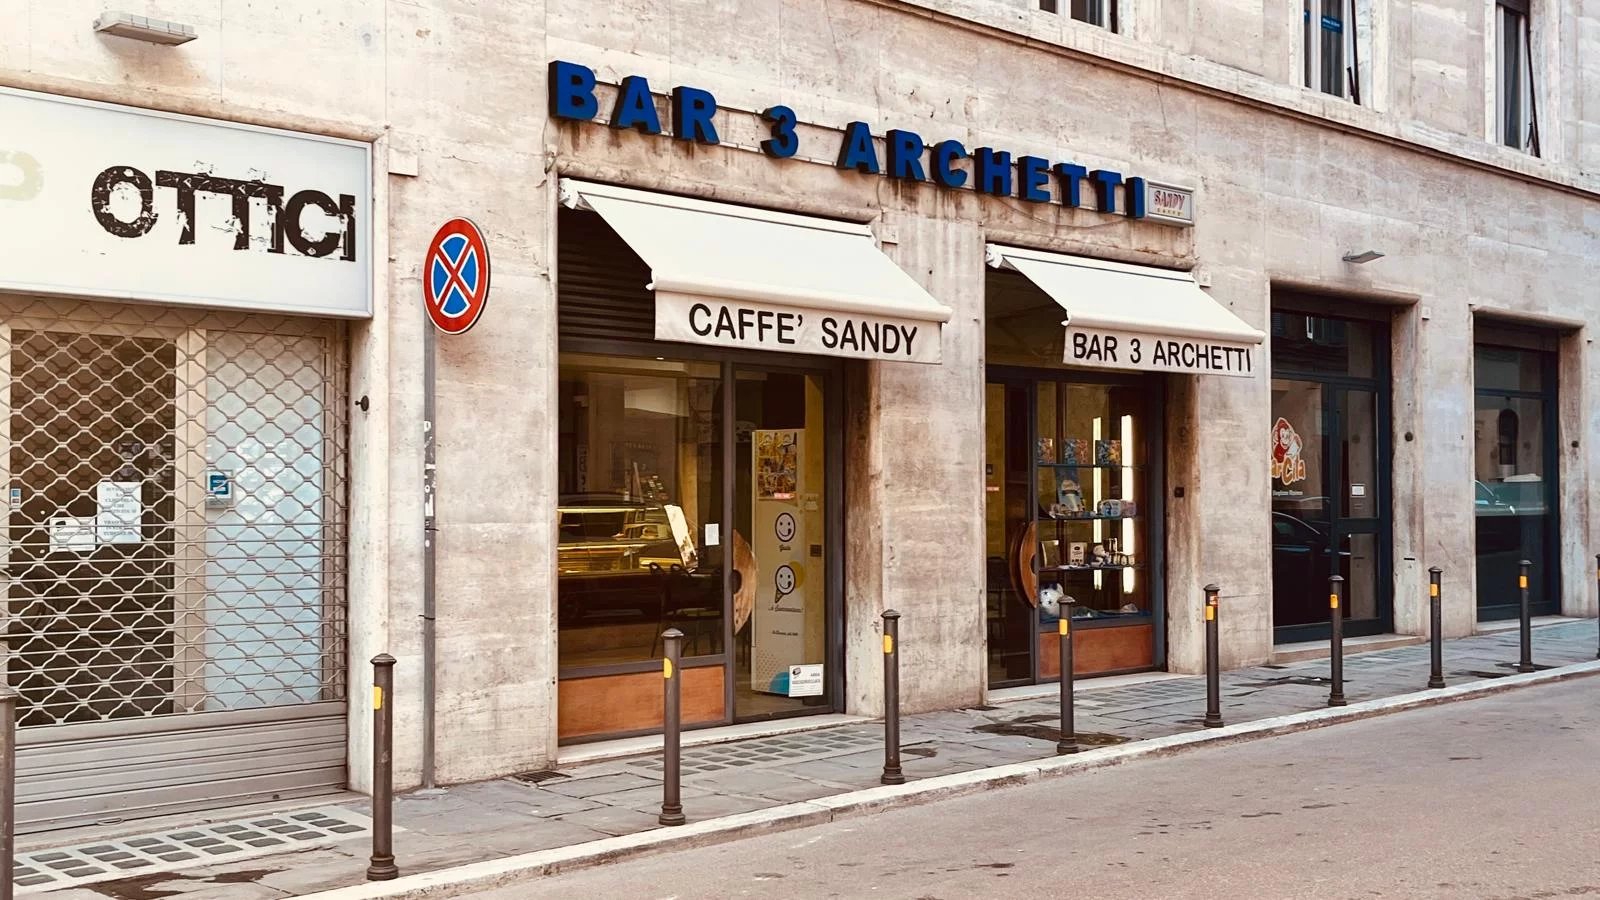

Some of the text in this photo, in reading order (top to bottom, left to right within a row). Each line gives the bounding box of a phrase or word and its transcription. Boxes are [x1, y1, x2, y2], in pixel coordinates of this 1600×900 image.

[549, 60, 1145, 218] BAR 3 ARCHETTI
[91, 165, 356, 262] OTTICI
[689, 303, 918, 355] CAFFE' SANDY
[1073, 332, 1251, 372] BAR 3 ARCHETTI
